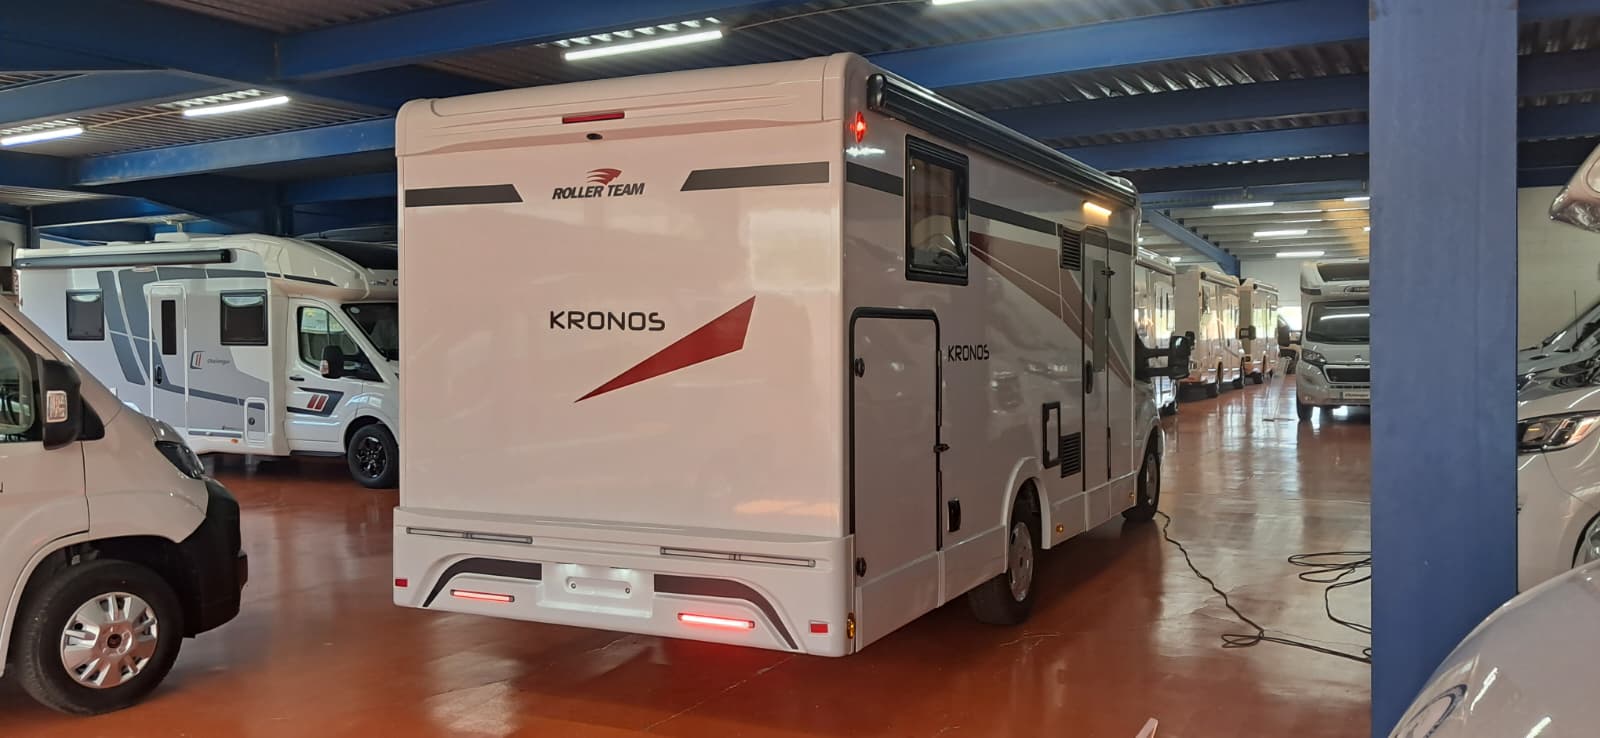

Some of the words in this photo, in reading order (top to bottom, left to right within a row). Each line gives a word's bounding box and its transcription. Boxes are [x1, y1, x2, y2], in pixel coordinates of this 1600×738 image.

[552, 185, 604, 200] ROLLER
[607, 182, 645, 197] TEAM
[550, 310, 666, 331] KRONOS
[947, 344, 990, 362] KRONOS
